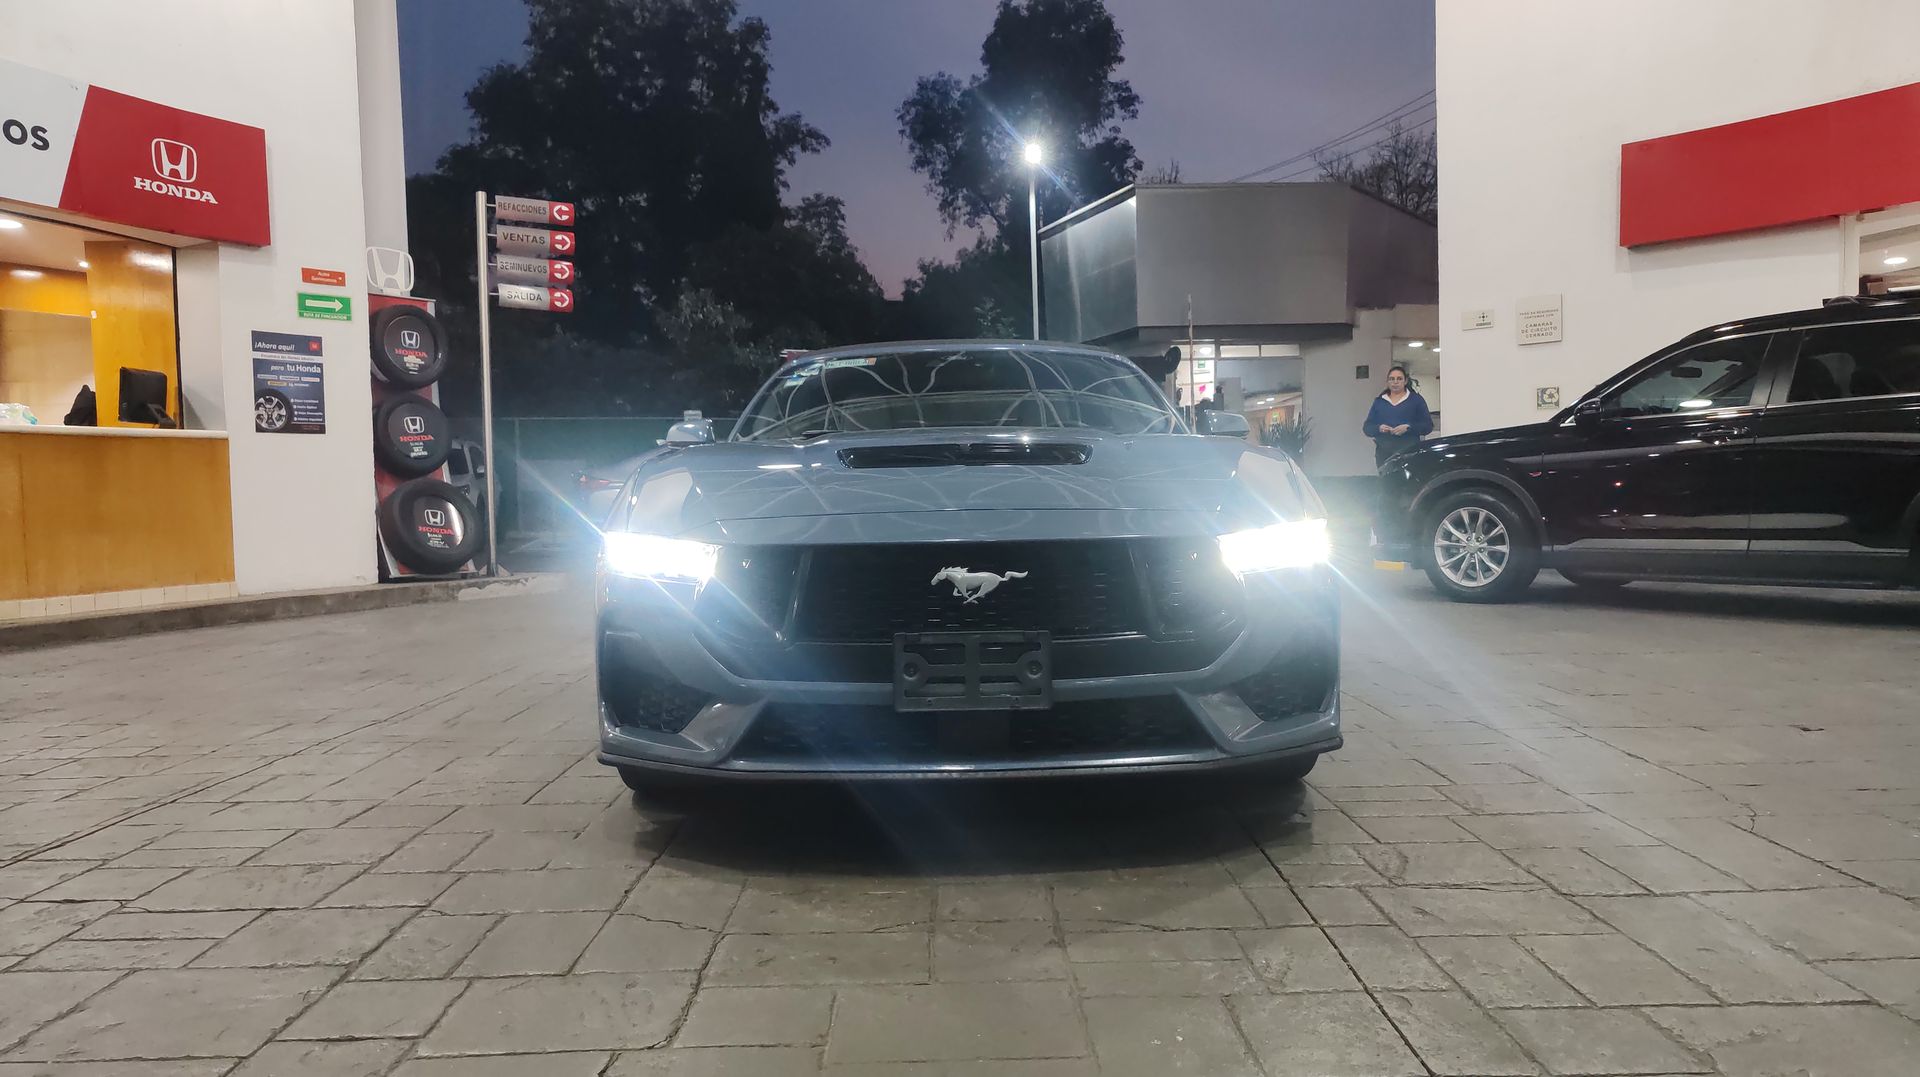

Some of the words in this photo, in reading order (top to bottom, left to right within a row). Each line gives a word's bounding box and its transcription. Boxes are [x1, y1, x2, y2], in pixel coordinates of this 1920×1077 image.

[133, 176, 218, 204] HONDA
[498, 201, 547, 215] REFACCIONES
[502, 232, 545, 245] VENTAS
[500, 261, 548, 274] SEMINUEVOS
[506, 290, 542, 302] SALIDA
[394, 348, 428, 358] HONDA
[286, 364, 295, 372] tu
[296, 364, 321, 373] Honda
[399, 434, 435, 443] HONDA
[418, 525, 455, 535] HONDA
